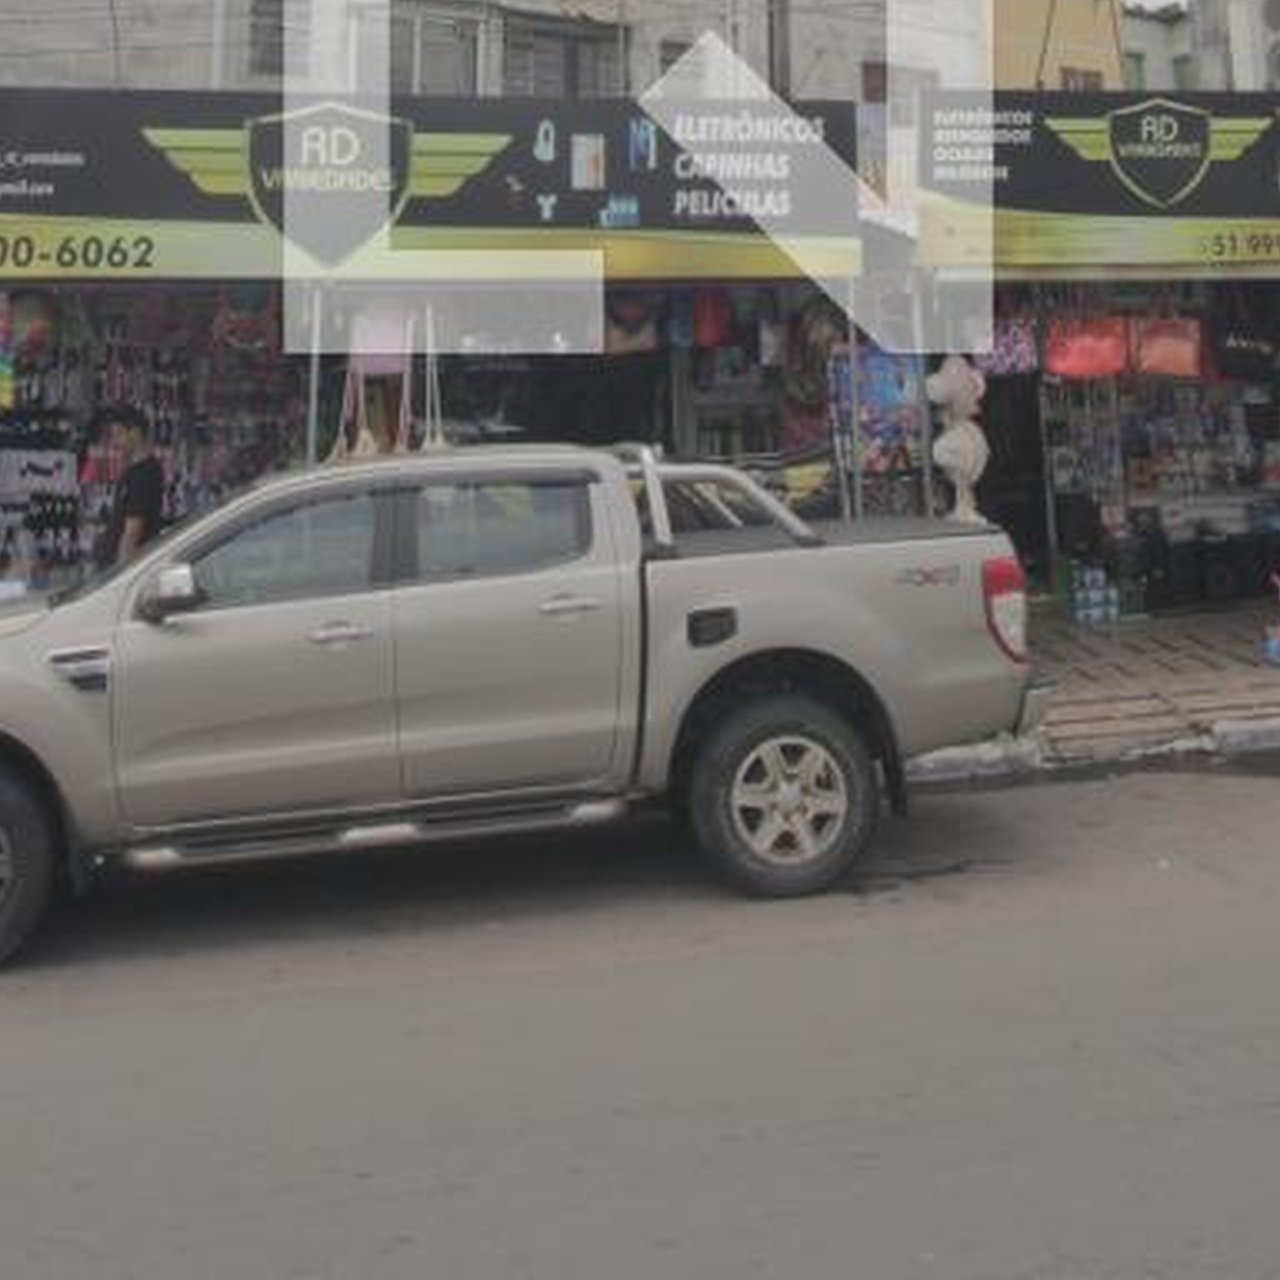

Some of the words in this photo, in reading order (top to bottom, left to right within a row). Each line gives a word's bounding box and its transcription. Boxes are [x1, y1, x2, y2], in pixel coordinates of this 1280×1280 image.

[1141, 115, 1179, 141] RD
[301, 126, 360, 166] RD
[674, 152, 790, 179] CAPINHAS
[1213, 234, 1238, 256] 51
